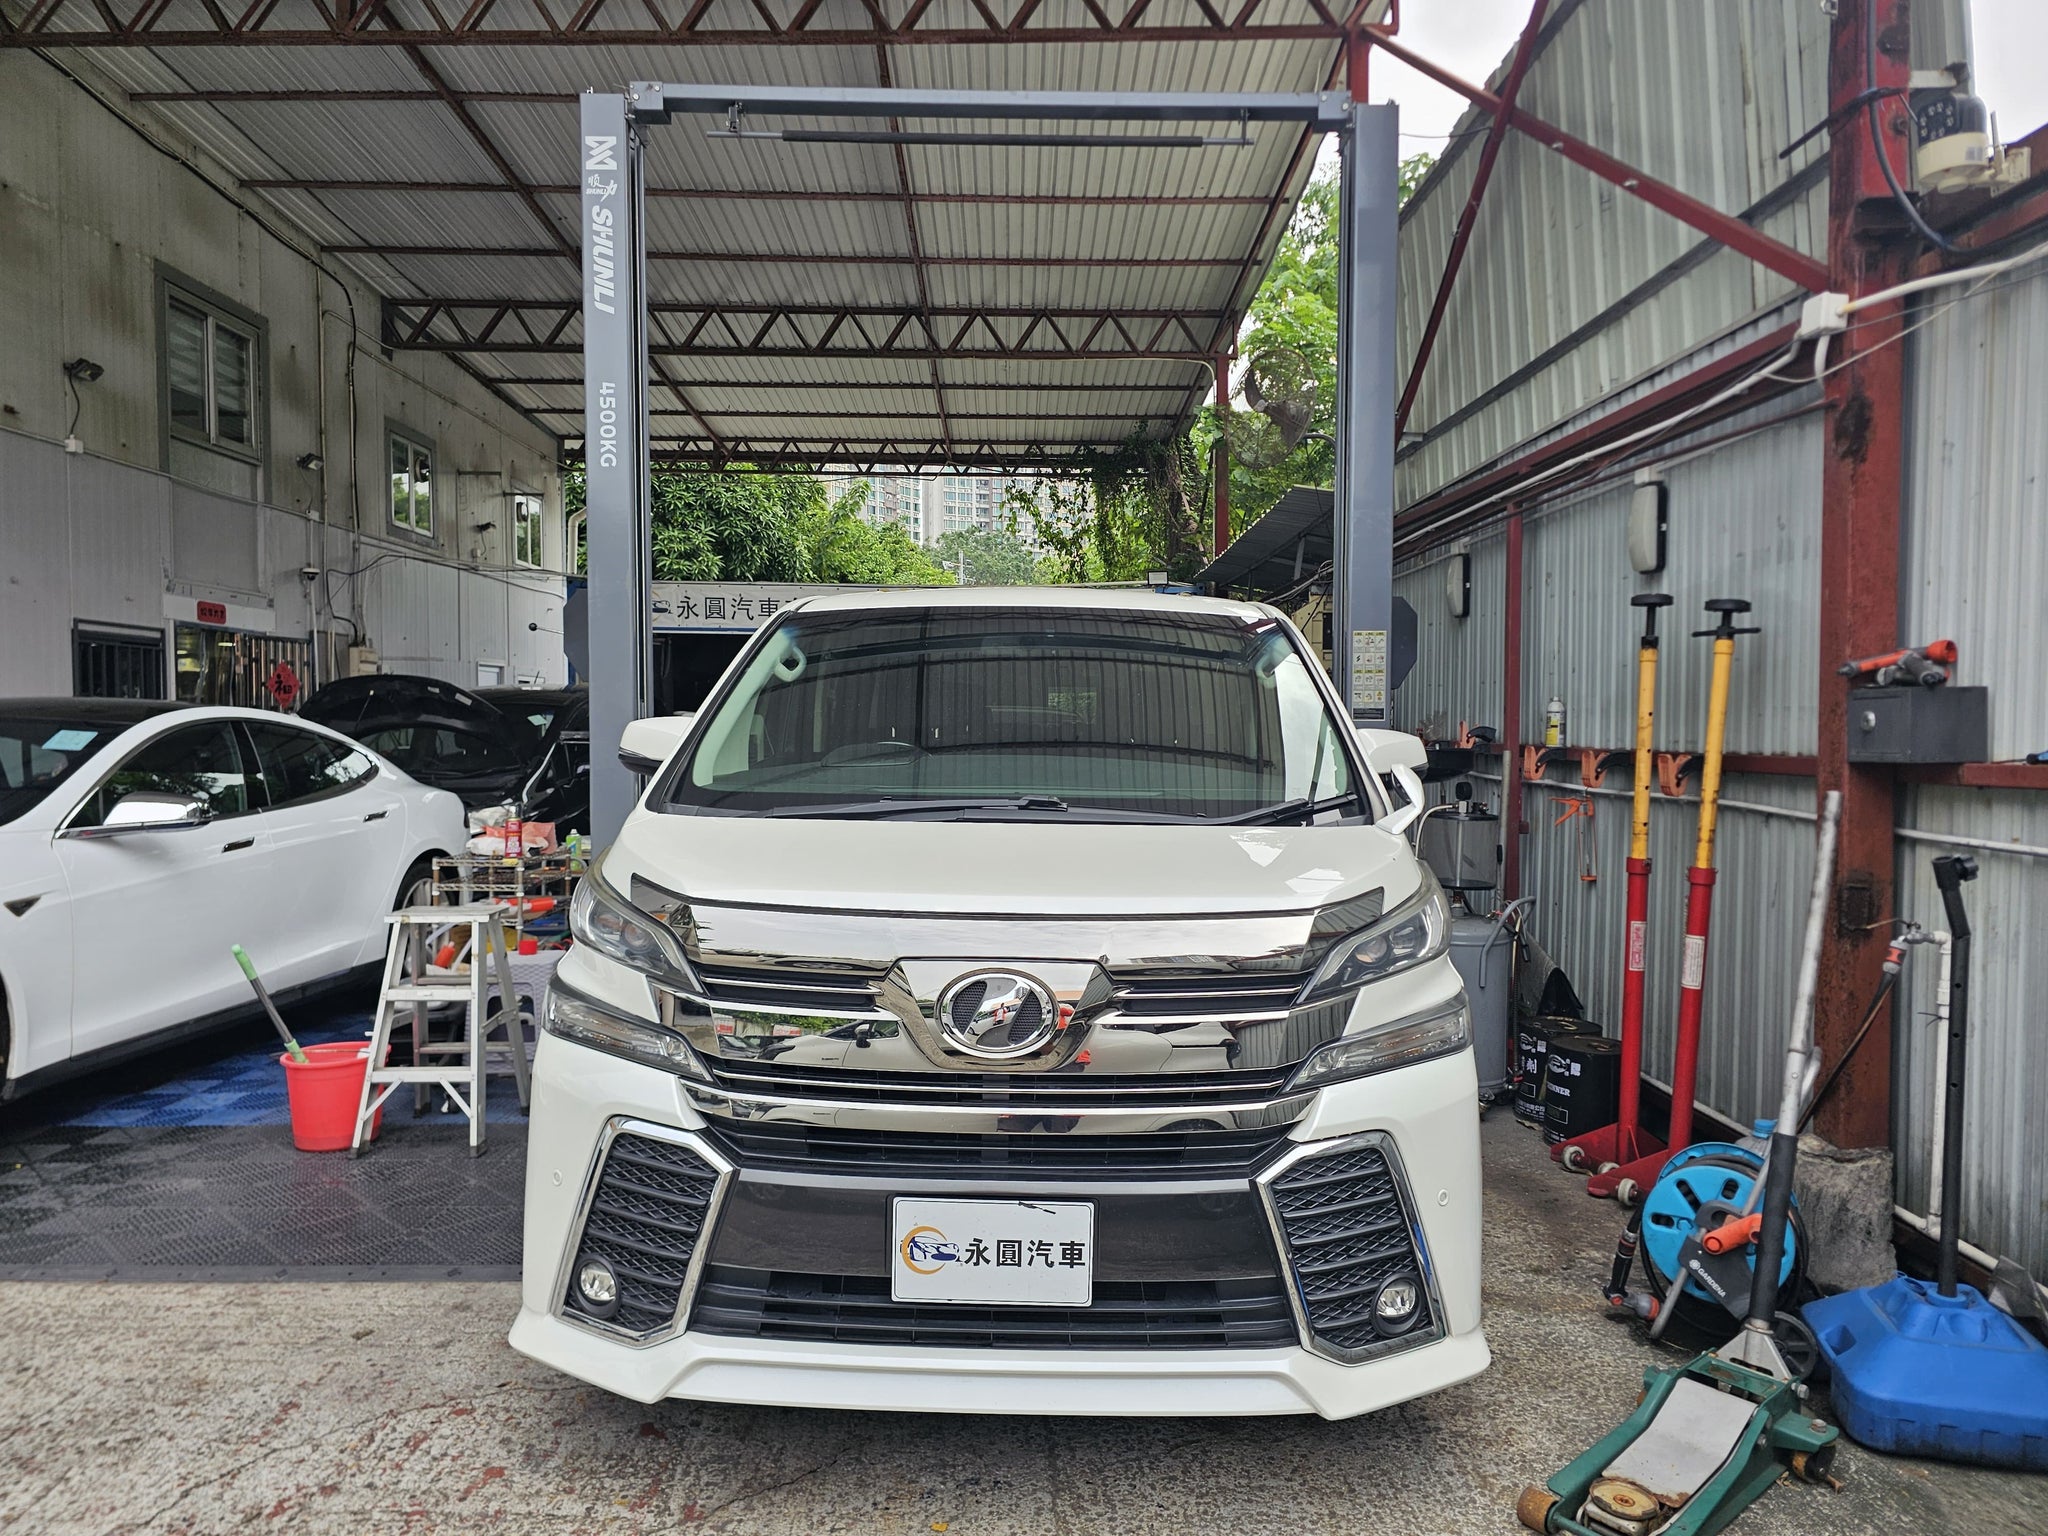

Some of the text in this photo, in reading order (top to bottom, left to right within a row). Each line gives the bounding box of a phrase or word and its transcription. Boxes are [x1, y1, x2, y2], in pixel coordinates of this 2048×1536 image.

[591, 204, 617, 315] SHUNLI
[599, 381, 618, 469] 4500KG
[677, 595, 798, 620] 永圓汽車
[964, 1237, 1086, 1269] 永圓汽車
[1697, 1267, 1727, 1298] GARDENA
